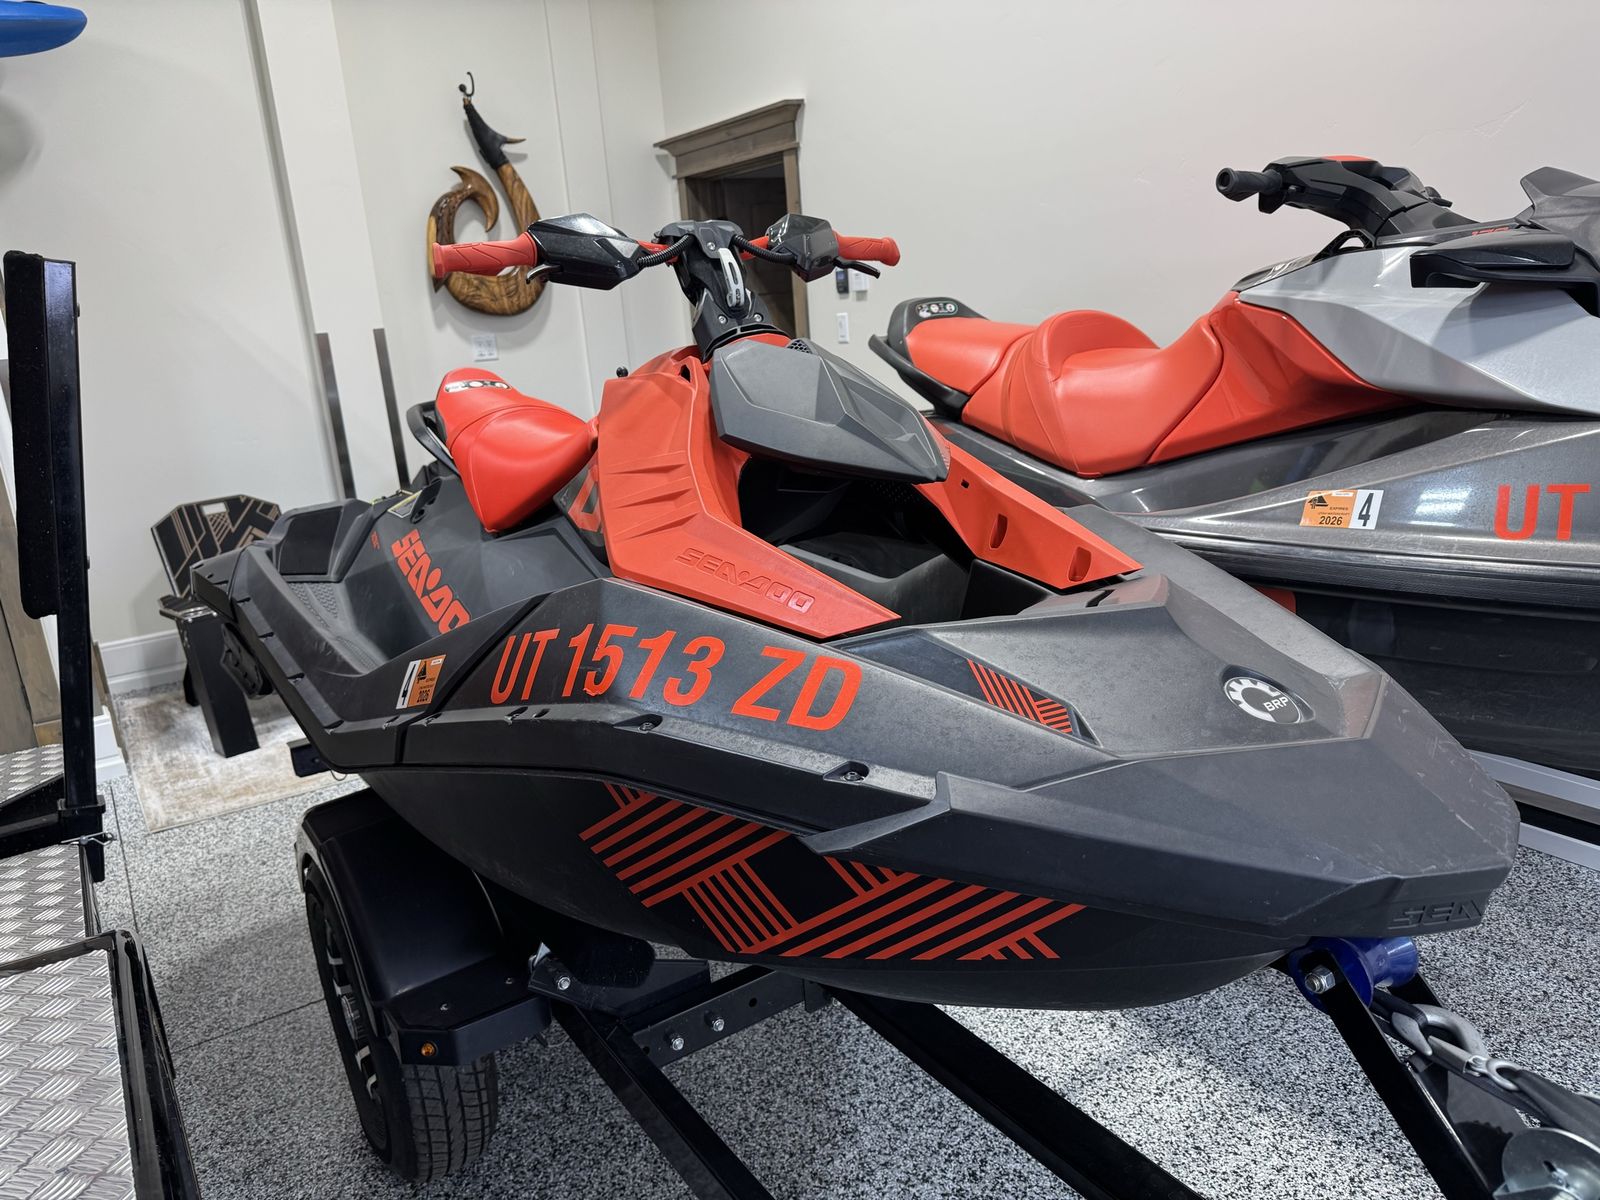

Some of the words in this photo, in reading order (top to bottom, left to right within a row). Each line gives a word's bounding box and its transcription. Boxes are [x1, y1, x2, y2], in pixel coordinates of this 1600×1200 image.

[1319, 515, 1343, 526] 2026
[1358, 492, 1375, 527] 4
[1494, 483, 1591, 541] UT
[490, 628, 560, 705] UT
[561, 623, 726, 707] 1513
[731, 645, 863, 731] ZD
[1262, 696, 1289, 712] BRP
